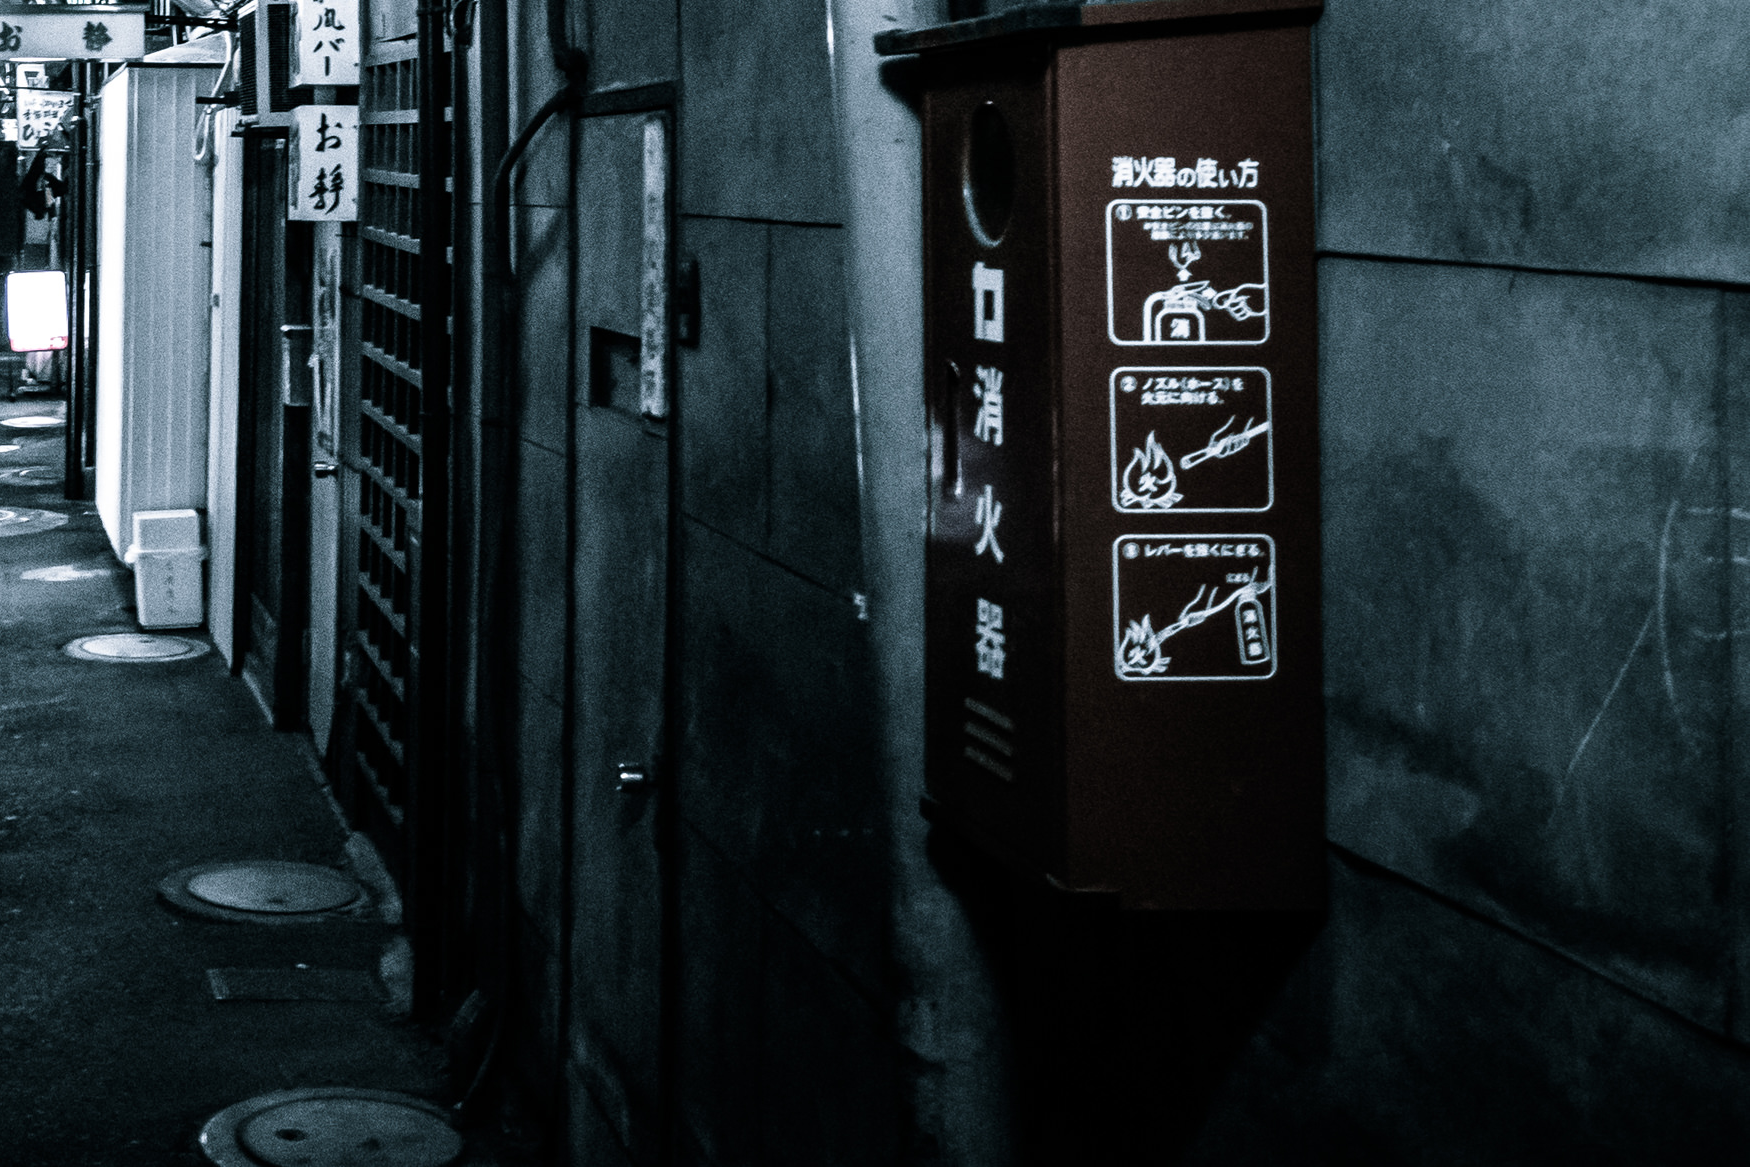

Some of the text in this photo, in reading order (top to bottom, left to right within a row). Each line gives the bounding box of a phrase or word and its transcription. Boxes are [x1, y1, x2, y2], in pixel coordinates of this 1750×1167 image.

[1111, 156, 1259, 188] 消火器の使い方
